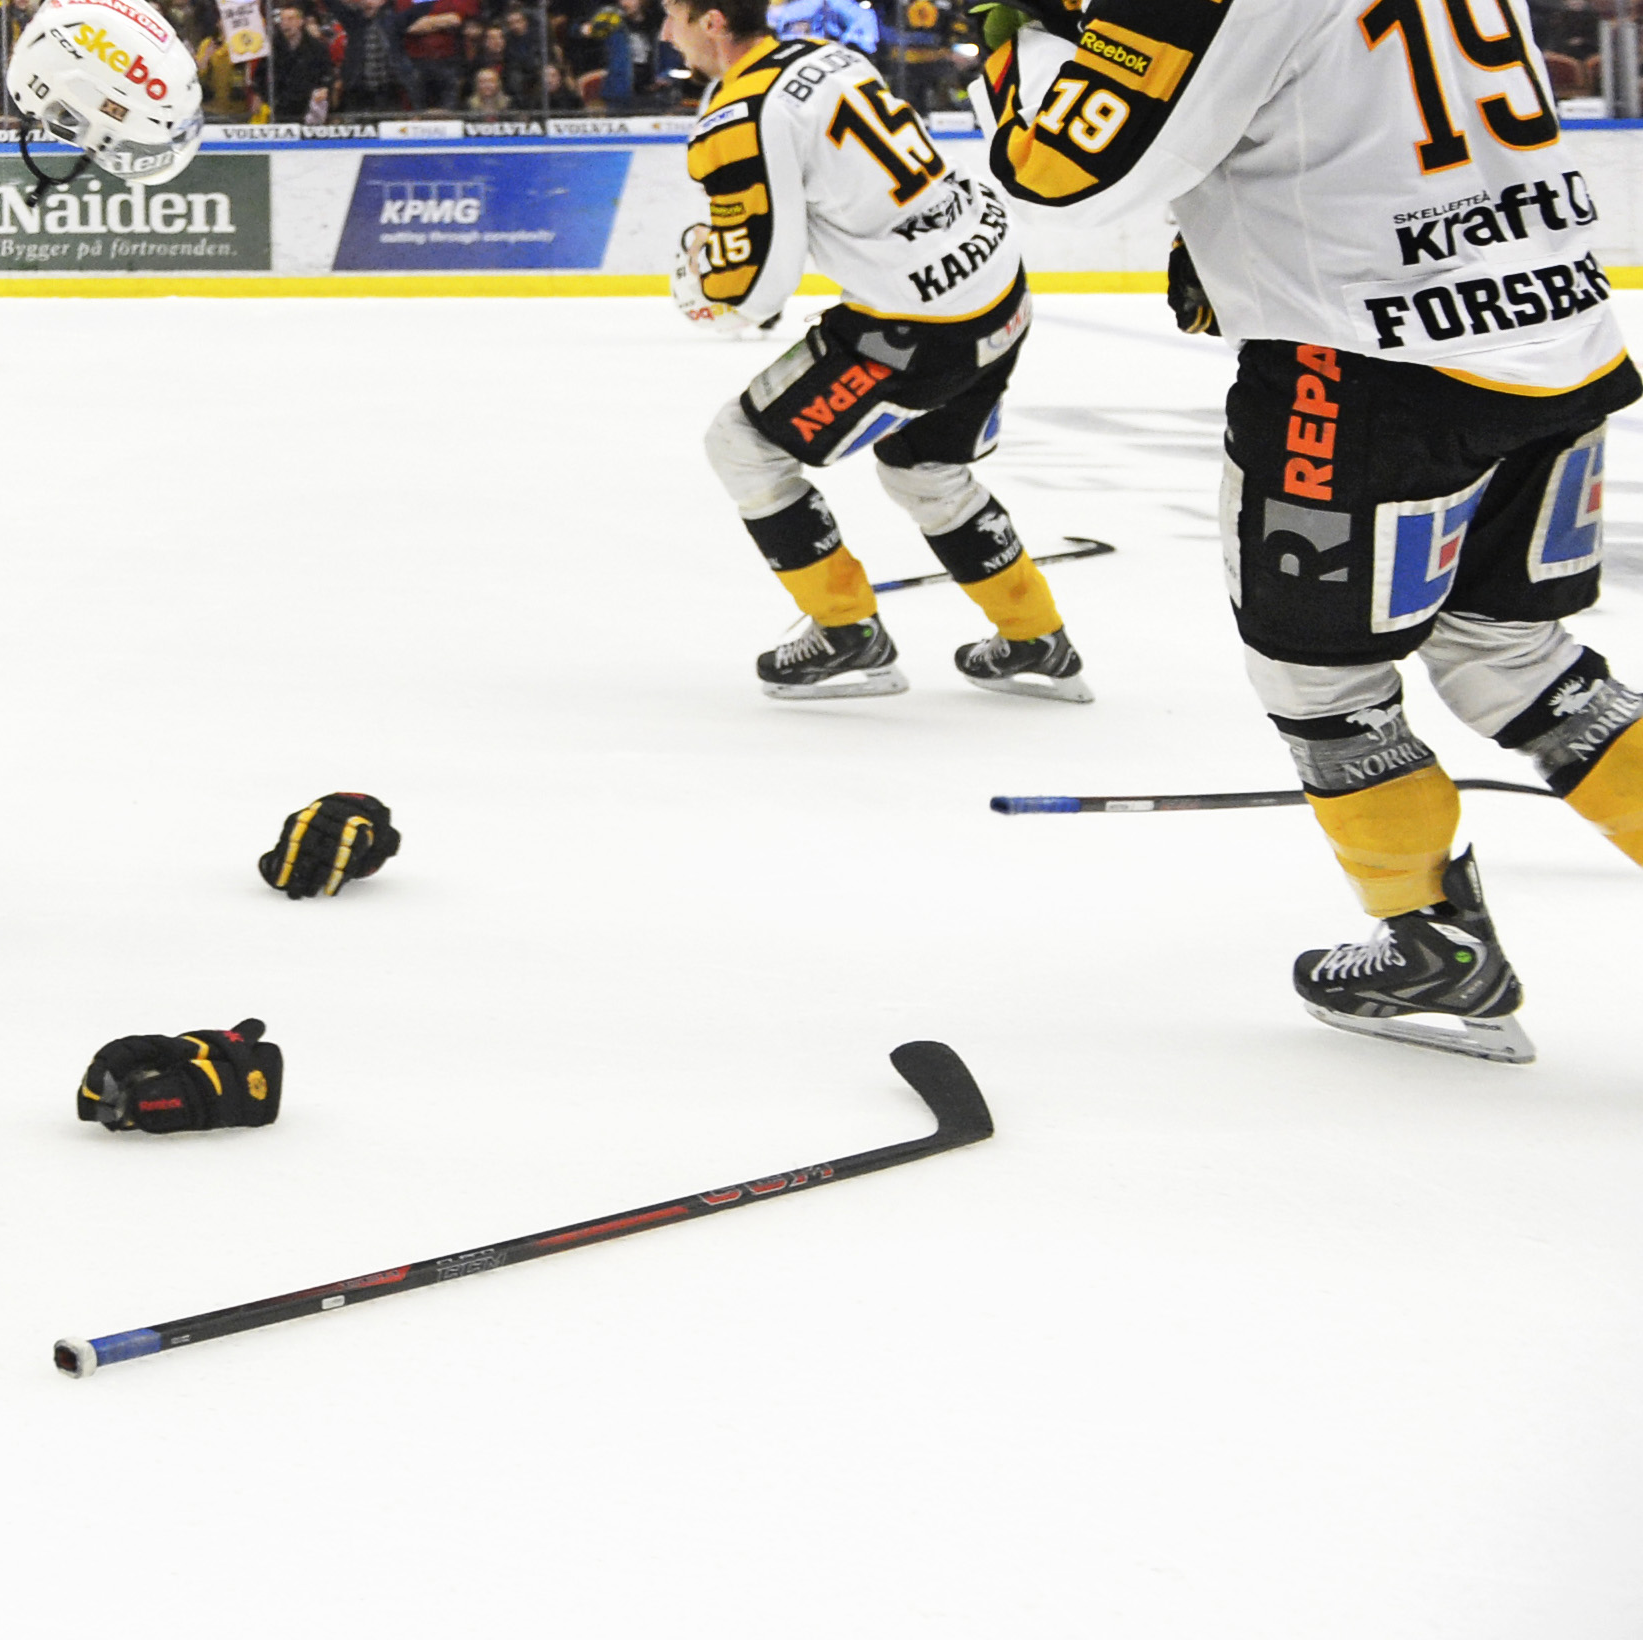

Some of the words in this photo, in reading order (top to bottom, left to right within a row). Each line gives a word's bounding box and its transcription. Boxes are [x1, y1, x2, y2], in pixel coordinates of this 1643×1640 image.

[73, 23, 168, 101] skebo
[1079, 31, 1147, 77] Reebok
[27, 73, 51, 101] 10
[302, 124, 378, 139] VOLVIA
[465, 121, 545, 137] VOLVIA
[554, 120, 630, 135] VOLVIA
[1036, 77, 1131, 154] 19
[223, 126, 297, 141] VOLVIA
[825, 76, 946, 208] 15
[379, 197, 482, 225] KPMG
[1396, 179, 1570, 266] kraft
[0, 238, 70, 260] Bygger
[75, 236, 104, 259] på
[706, 228, 752, 267] 15
[1283, 344, 1342, 501] REPA
